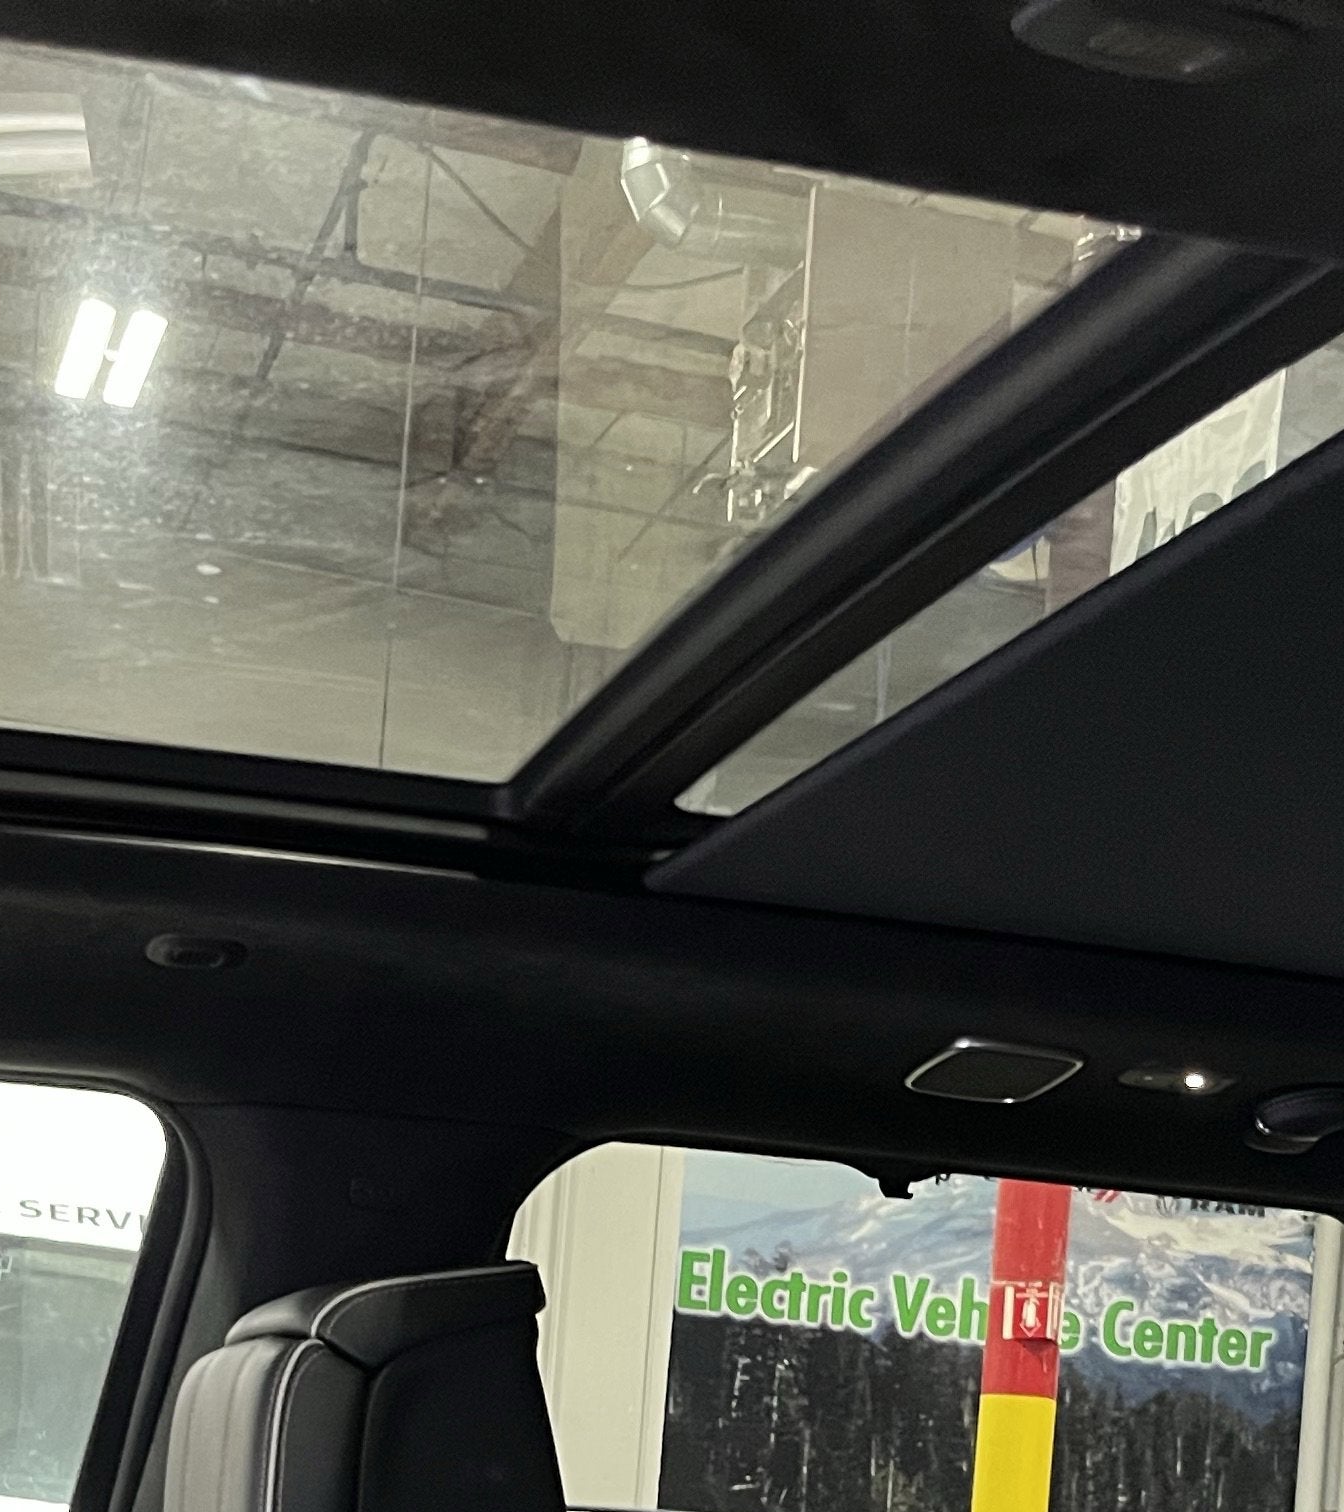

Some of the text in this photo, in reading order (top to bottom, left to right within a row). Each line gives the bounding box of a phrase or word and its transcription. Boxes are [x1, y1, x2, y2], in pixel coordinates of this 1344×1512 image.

[677, 1248, 1273, 1369] Electric Vehe Center
